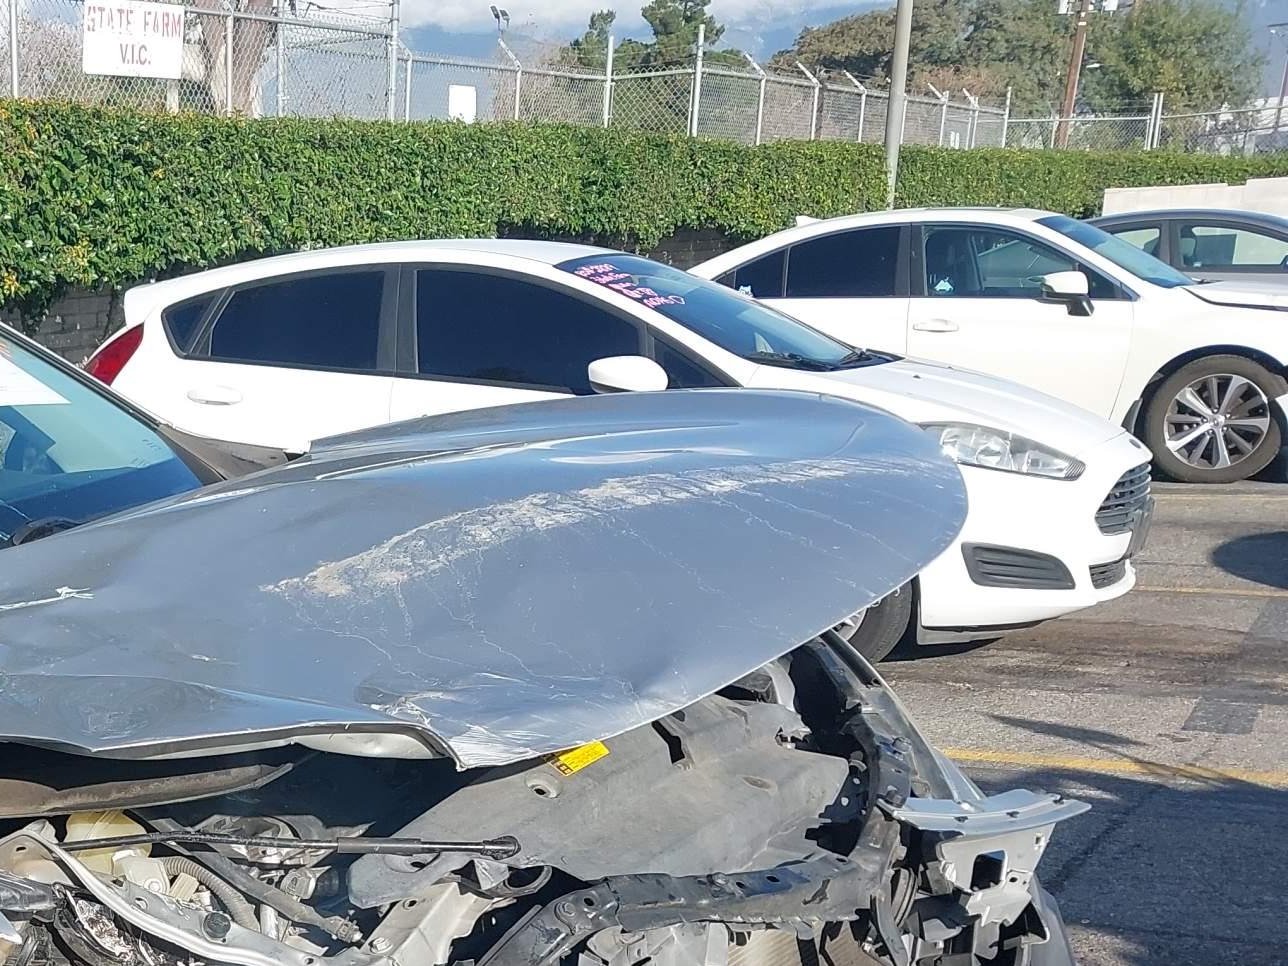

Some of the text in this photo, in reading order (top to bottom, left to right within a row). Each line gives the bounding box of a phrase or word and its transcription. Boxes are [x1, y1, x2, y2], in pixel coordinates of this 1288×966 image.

[87, 5, 182, 38] STATE FARM
[119, 42, 151, 66] V.I.C.
